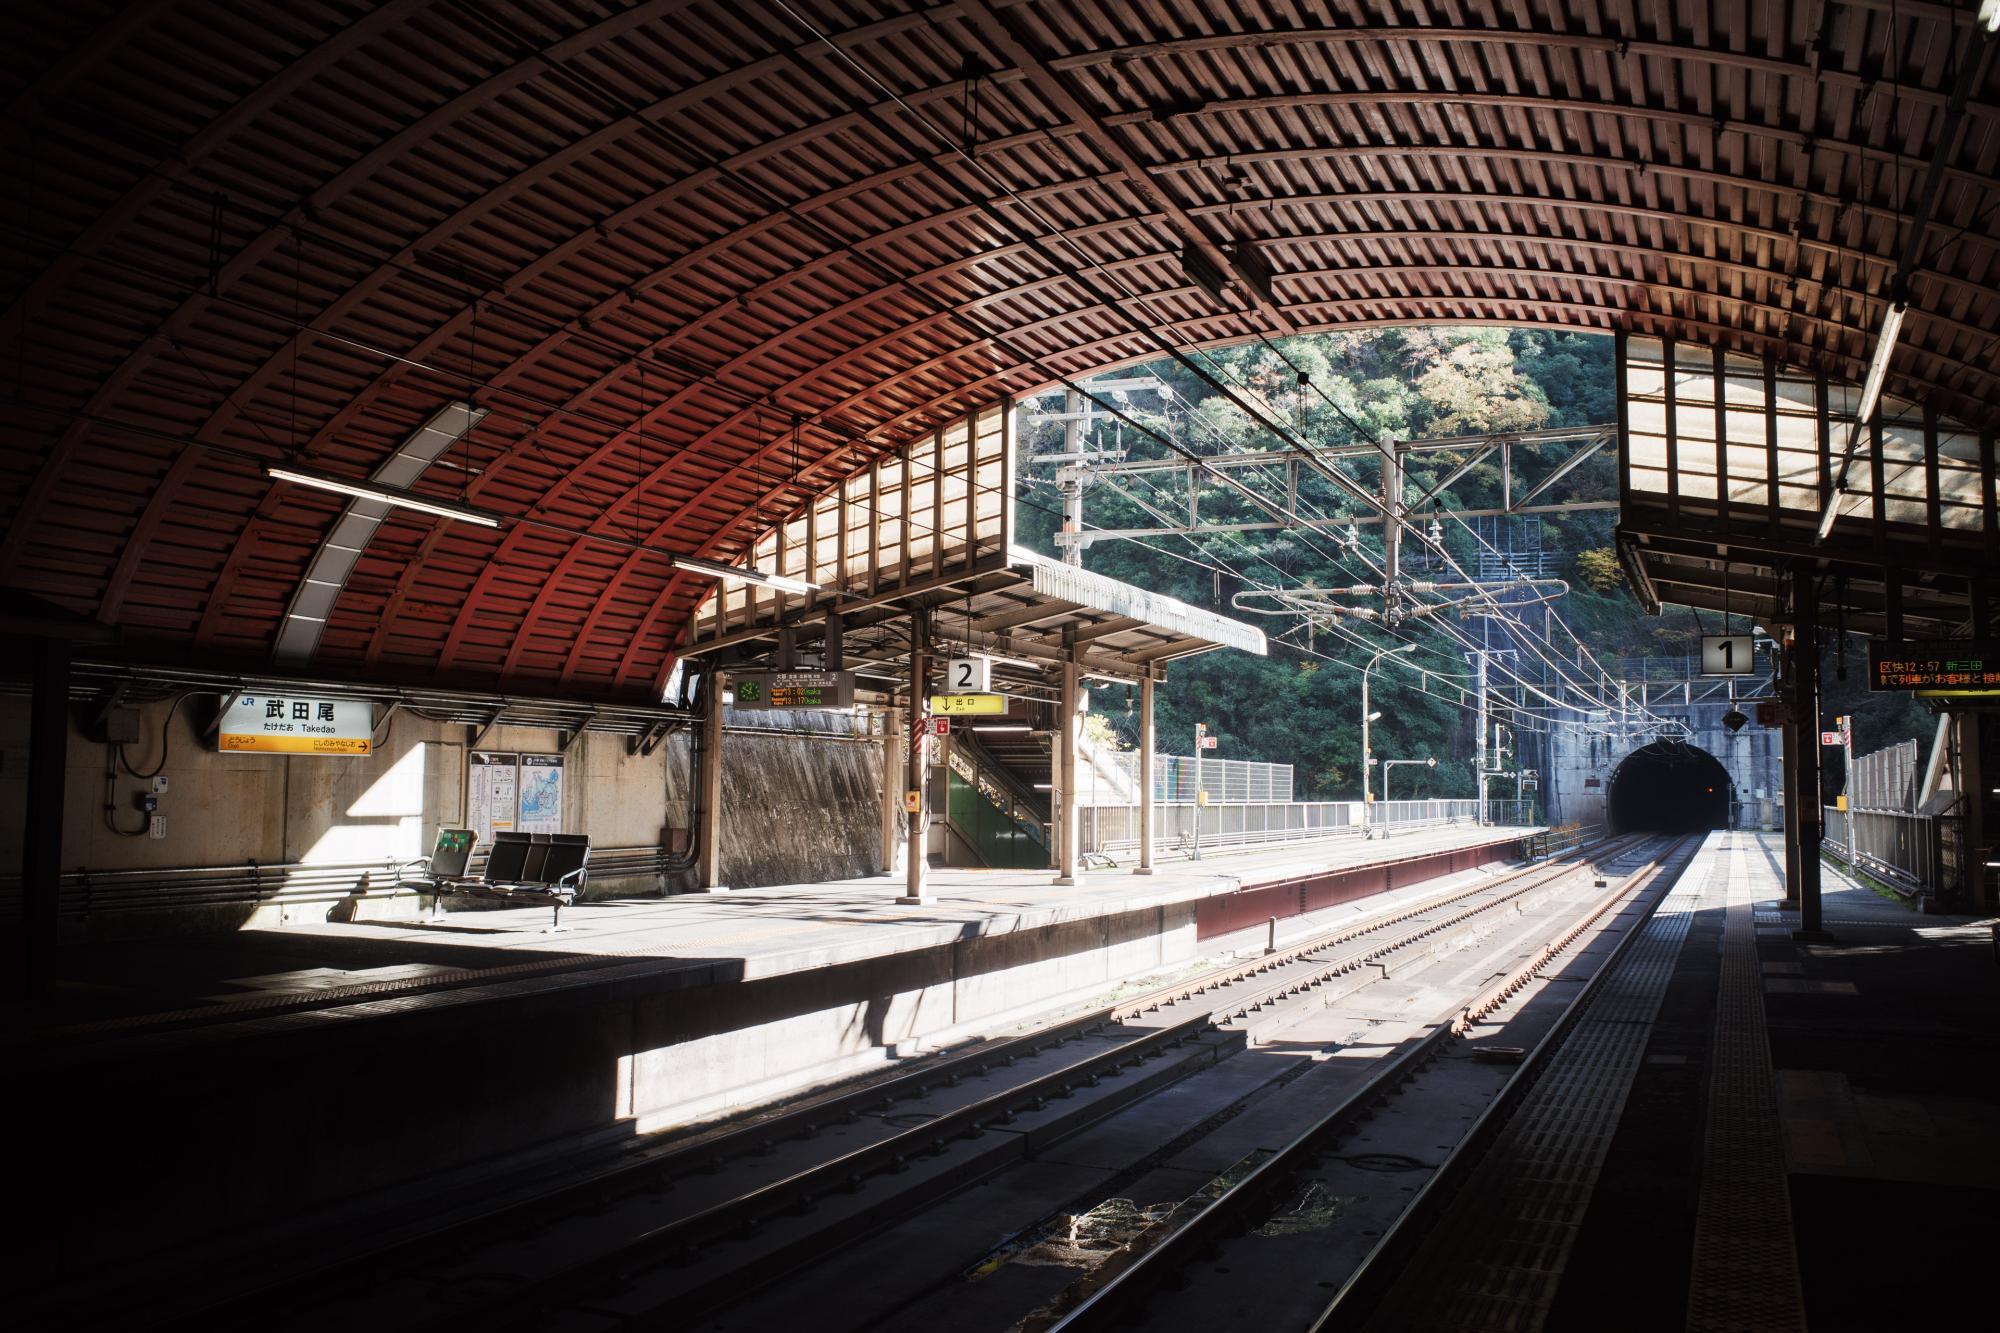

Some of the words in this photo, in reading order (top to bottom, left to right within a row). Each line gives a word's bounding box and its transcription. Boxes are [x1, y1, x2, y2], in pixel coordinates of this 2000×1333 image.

[1717, 640, 1733, 669] 1
[1945, 660, 1982, 671] 新三田
[957, 663, 973, 687] 2
[241, 697, 255, 706] JR
[955, 698, 975, 706] 出口
[265, 699, 335, 722] 武田尾
[263, 722, 294, 732] たけだお
[302, 724, 336, 734] Takedao
